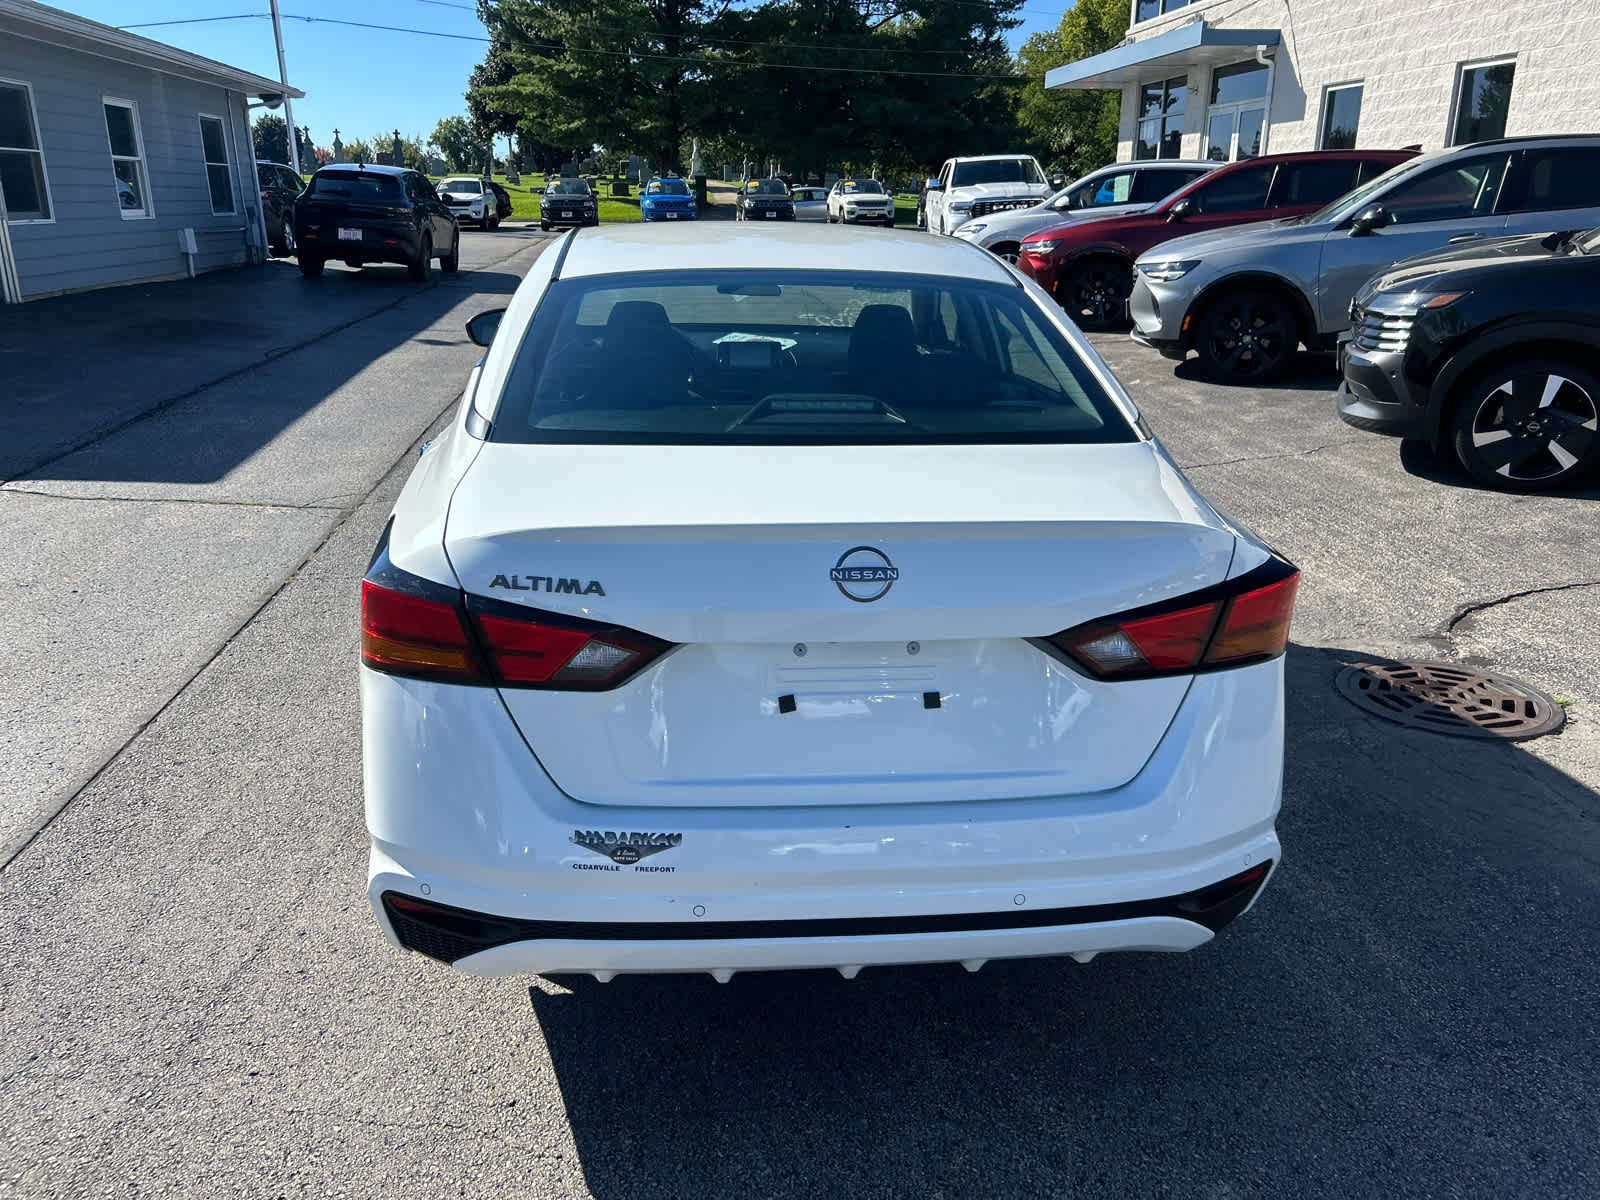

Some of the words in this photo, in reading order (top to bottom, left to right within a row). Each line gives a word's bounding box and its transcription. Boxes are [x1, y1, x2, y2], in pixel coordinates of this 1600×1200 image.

[832, 570, 897, 580] NISSAN
[488, 574, 606, 597] ALTIMA
[572, 863, 620, 872] CEDARVILLE
